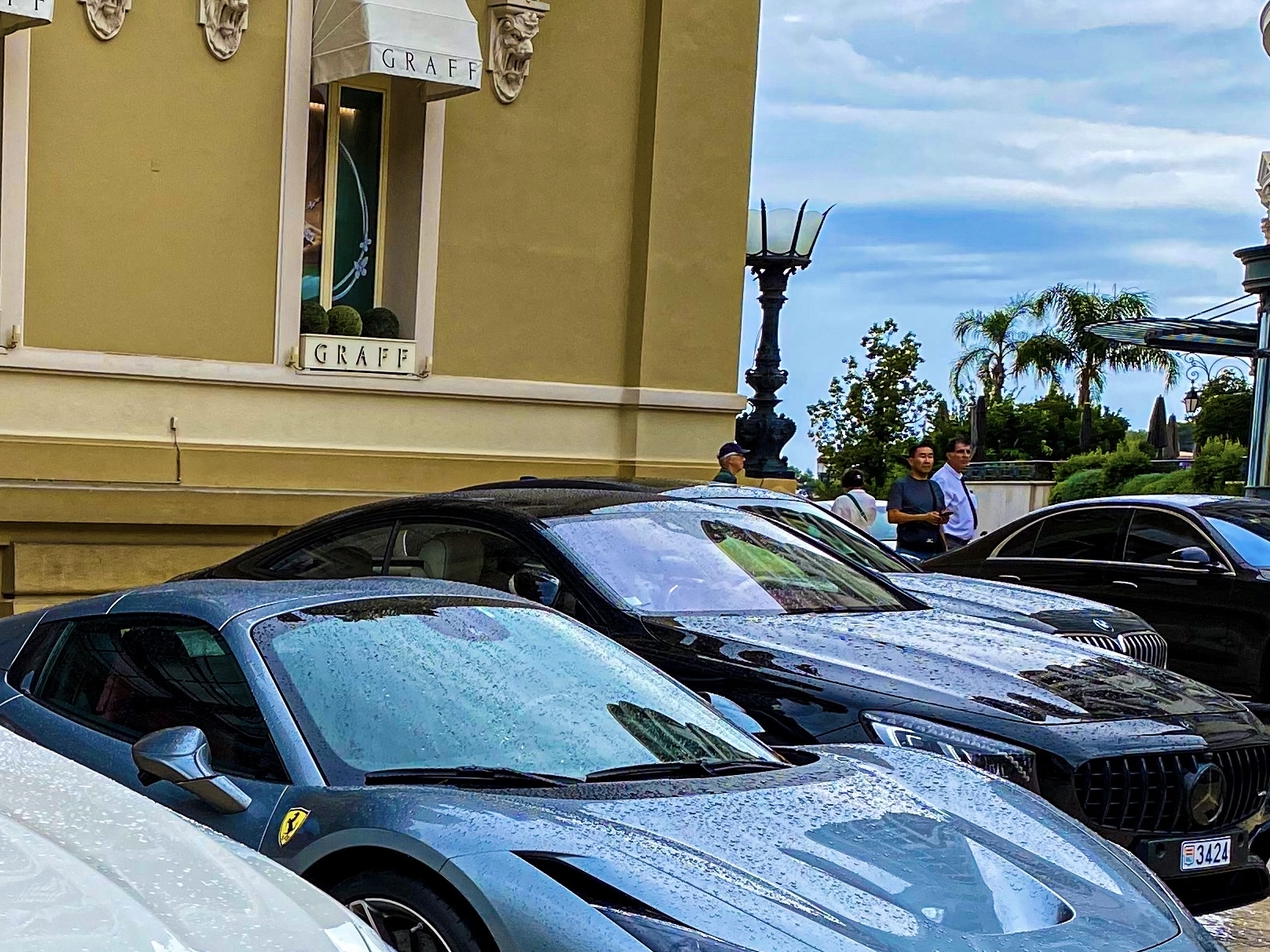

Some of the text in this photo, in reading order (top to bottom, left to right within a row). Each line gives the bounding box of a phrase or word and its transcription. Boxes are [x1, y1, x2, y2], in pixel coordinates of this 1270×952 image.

[382, 48, 478, 81] GRAFF
[314, 343, 408, 368] GRAFF
[1196, 842, 1229, 865] 3424
